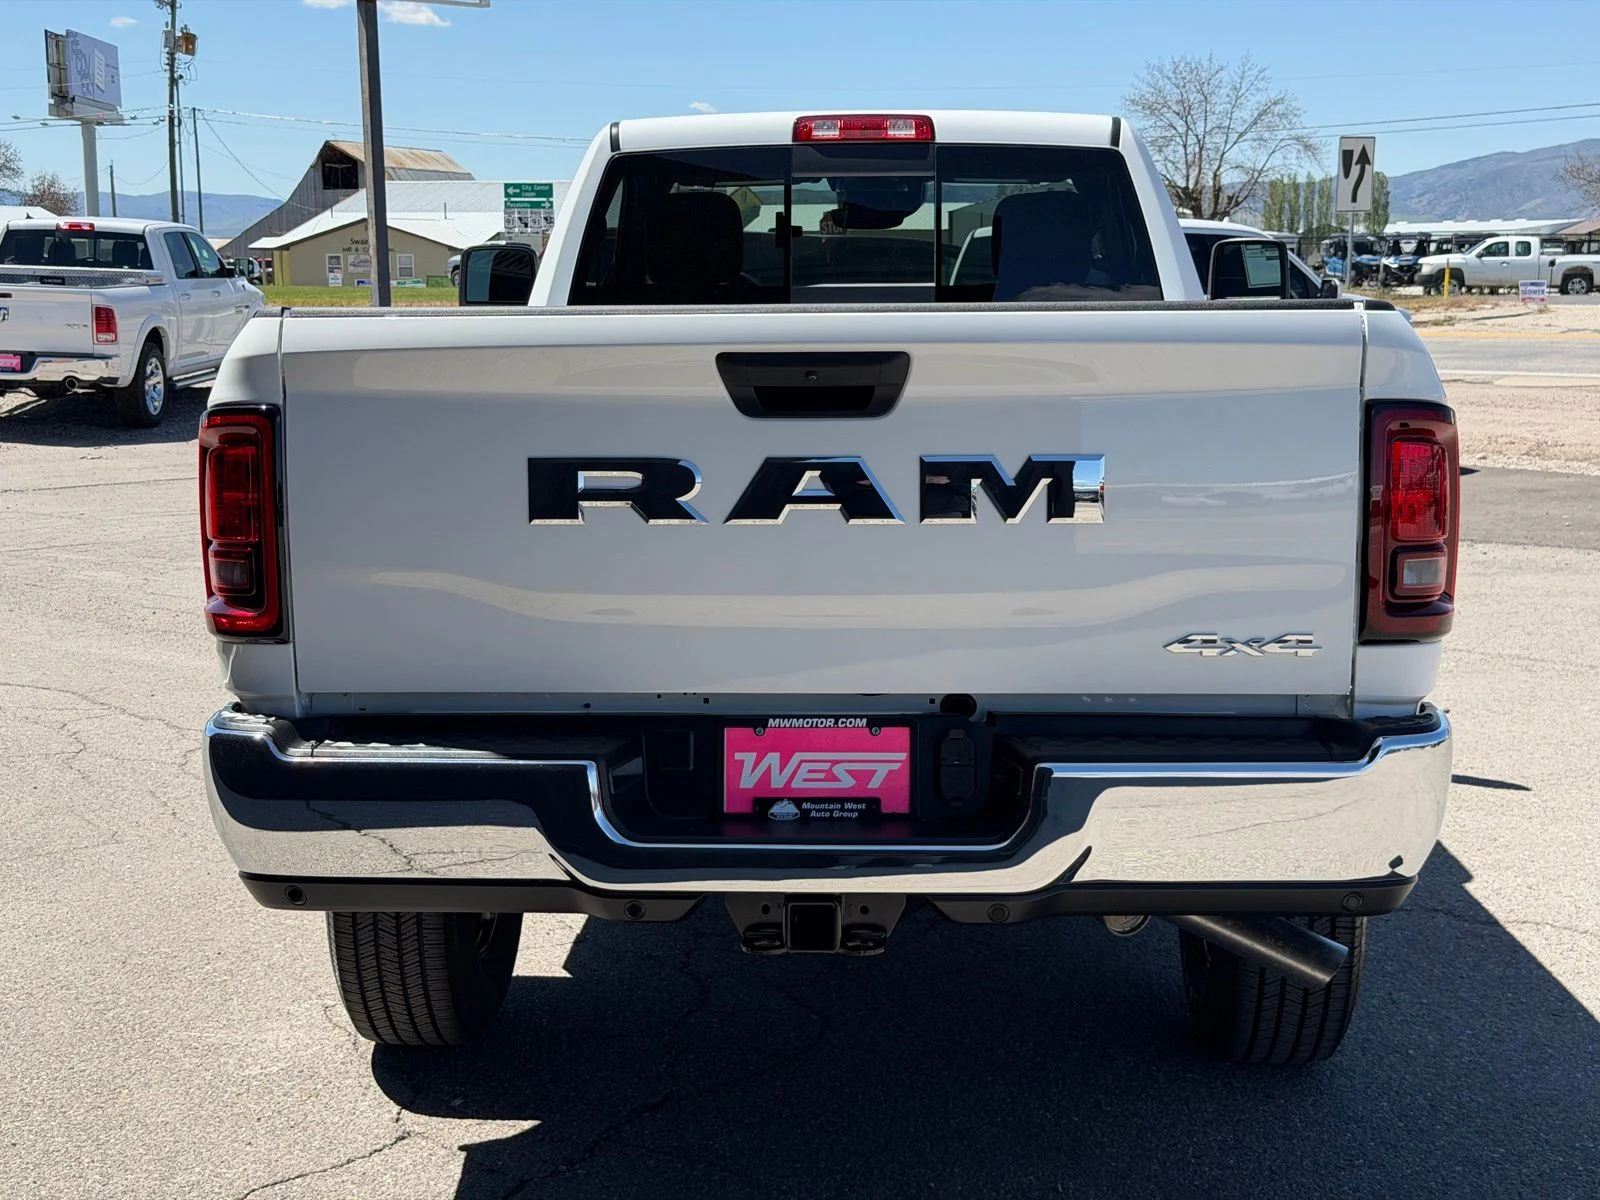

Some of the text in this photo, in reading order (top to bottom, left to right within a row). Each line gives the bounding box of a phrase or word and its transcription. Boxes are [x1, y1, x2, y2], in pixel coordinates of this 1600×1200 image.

[527, 454, 1105, 525] RAM
[768, 718, 867, 728] MWMOTOR.COM
[833, 810, 858, 818] Group
